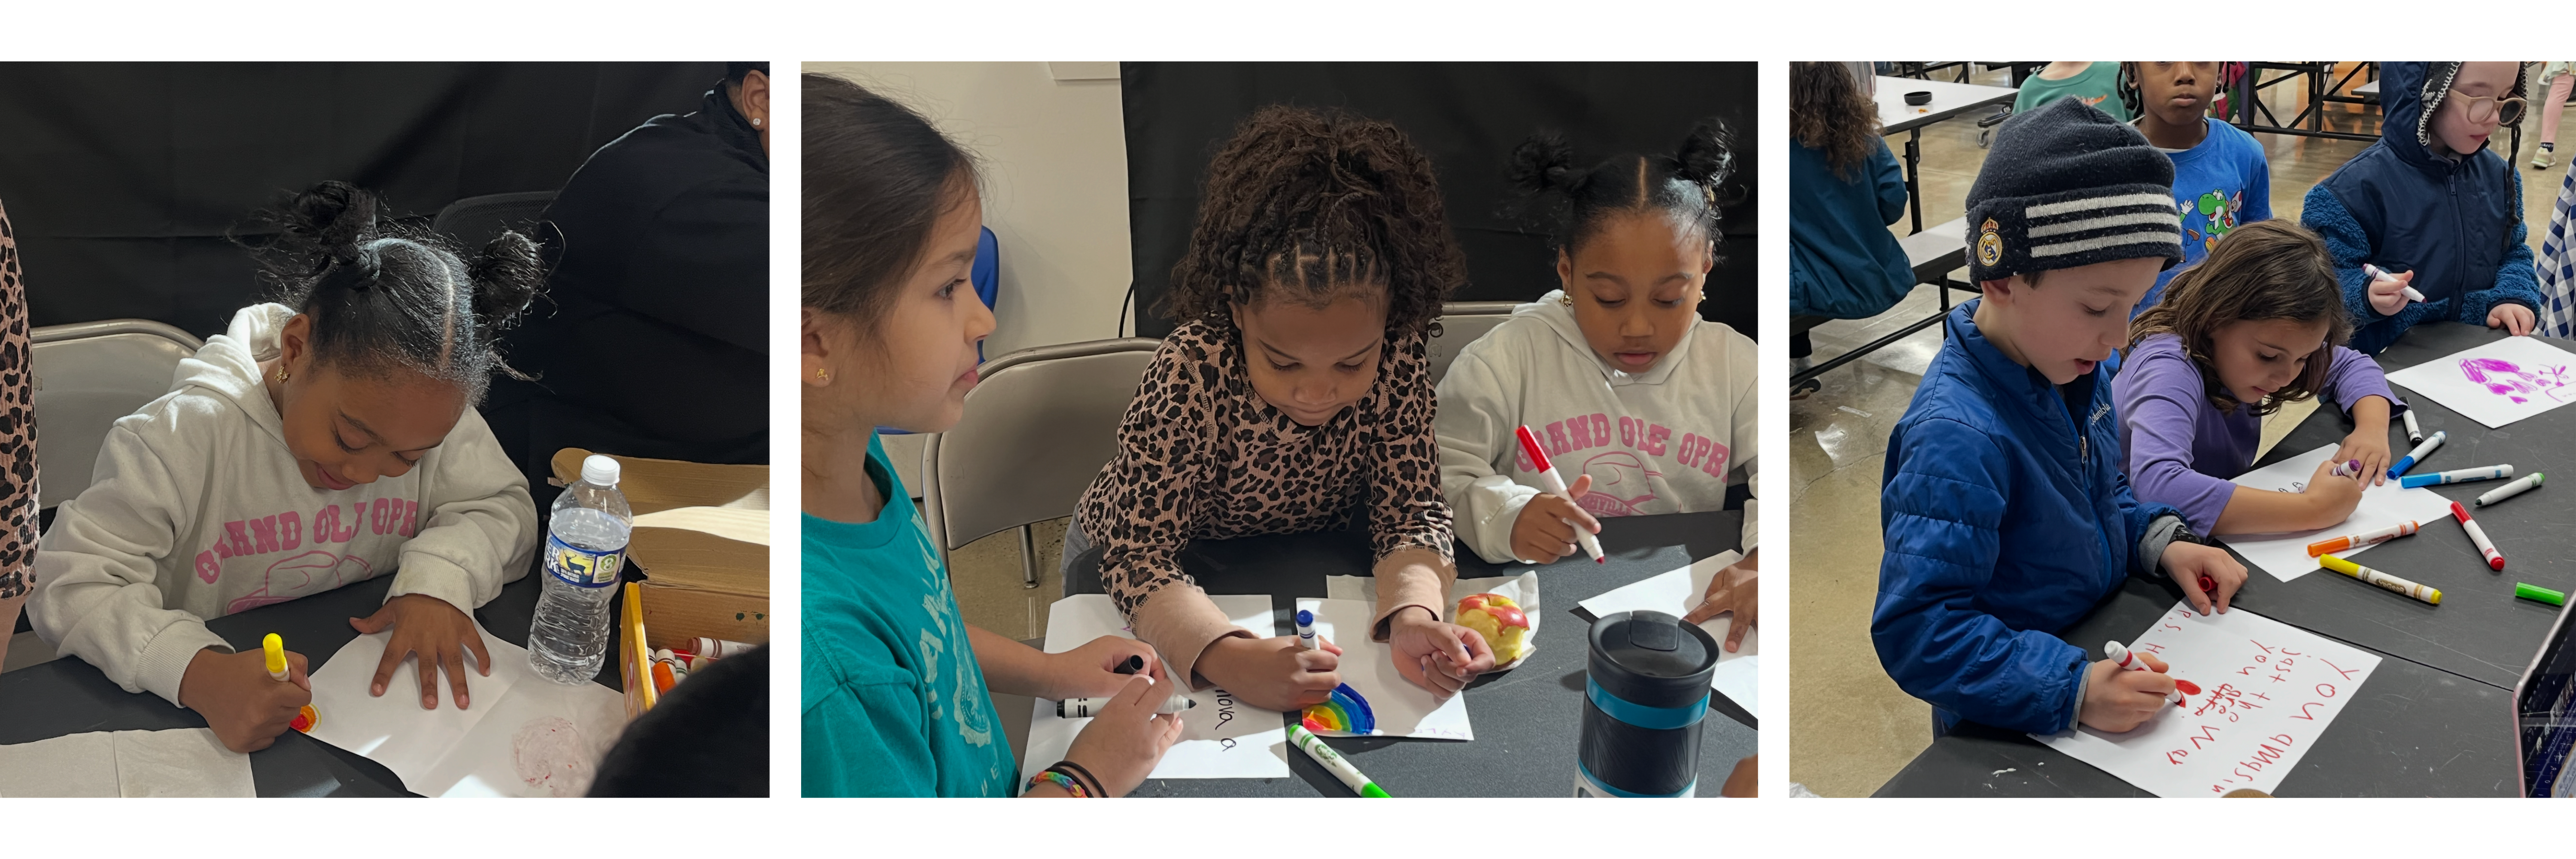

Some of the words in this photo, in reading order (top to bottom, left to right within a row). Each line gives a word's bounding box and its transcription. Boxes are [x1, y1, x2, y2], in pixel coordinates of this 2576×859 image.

[2089, 403, 2111, 425] olumbia
[1619, 416, 1671, 456] OLE
[1677, 433, 1729, 484] OPR
